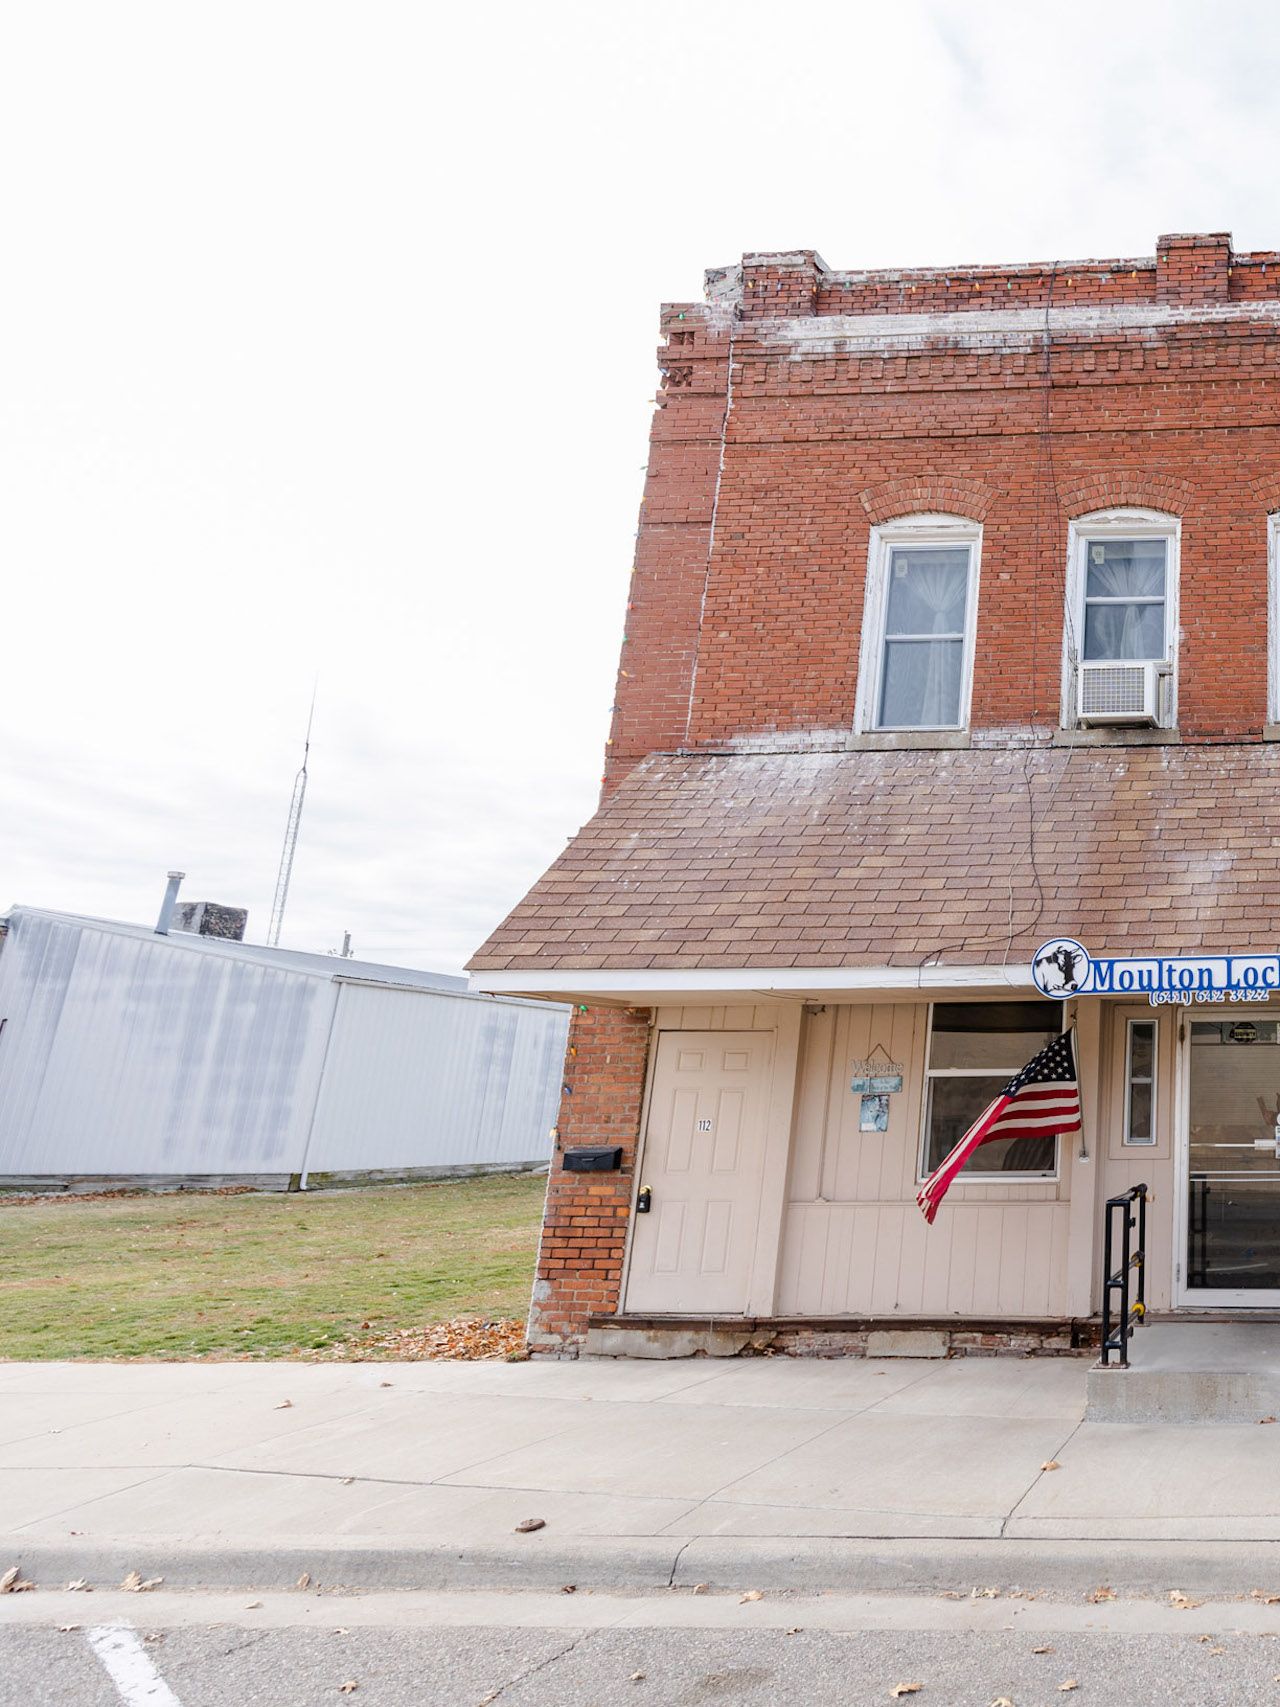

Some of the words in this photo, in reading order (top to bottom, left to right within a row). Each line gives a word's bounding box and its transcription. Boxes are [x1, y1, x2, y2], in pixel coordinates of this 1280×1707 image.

[1090, 957, 1214, 992] Moulton
[1150, 988, 1190, 1006] (641)
[1196, 987, 1224, 1002] 642
[1231, 986, 1269, 1001] 3422
[852, 1059, 904, 1073] Welcome
[698, 1119, 711, 1131] 112
